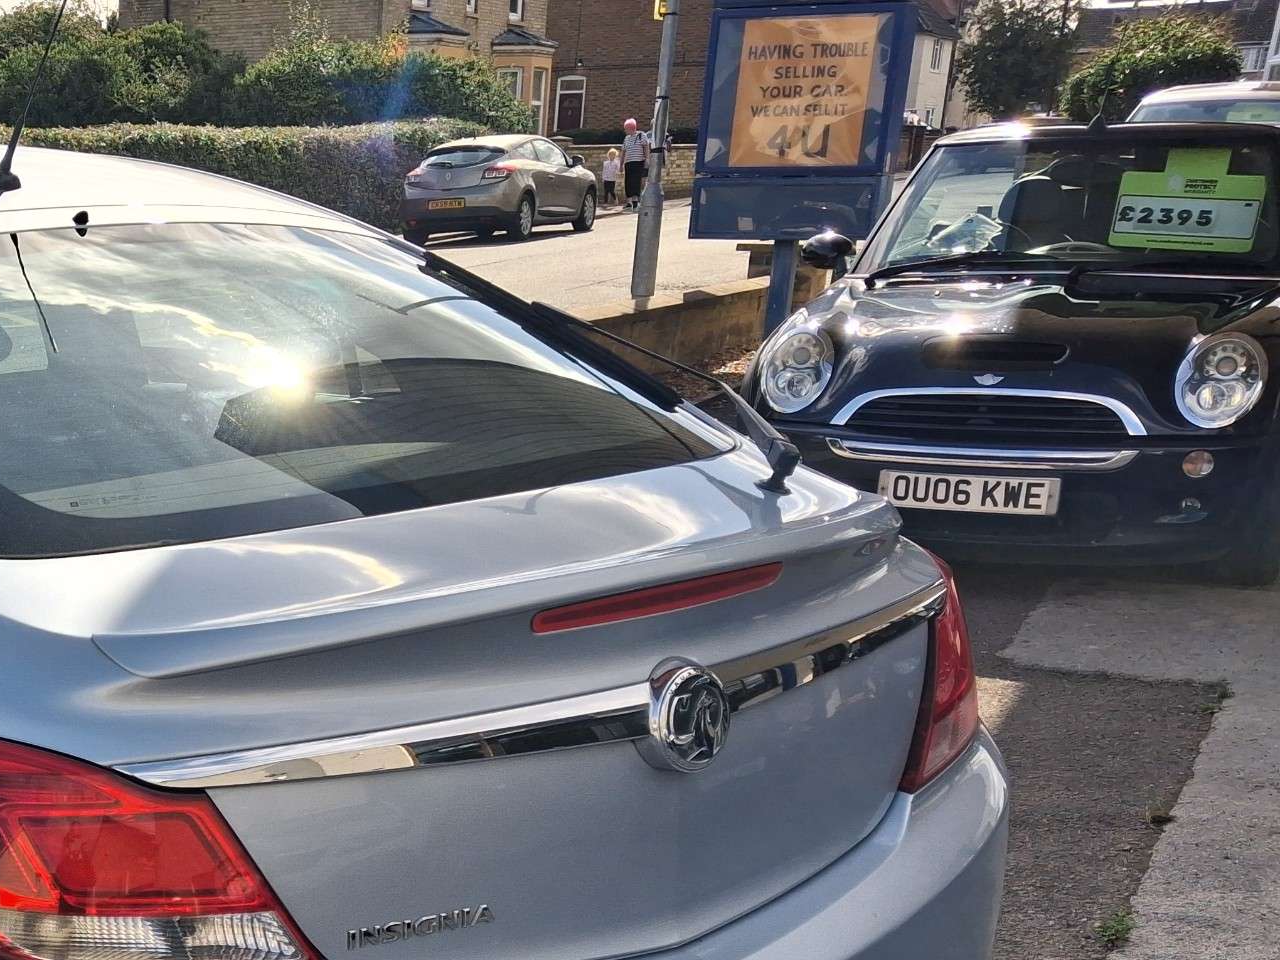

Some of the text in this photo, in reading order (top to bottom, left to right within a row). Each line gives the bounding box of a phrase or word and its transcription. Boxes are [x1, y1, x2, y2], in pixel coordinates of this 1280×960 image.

[748, 42, 869, 60] HAVING TROUBLE
[774, 65, 837, 79] SELLING
[760, 85, 802, 98] YOUR
[750, 103, 848, 117] WE CAN SELL IT
[1118, 206, 1213, 227] £2395
[892, 474, 1045, 510] OU06 KWE
[346, 904, 496, 951] INSIGNIA
